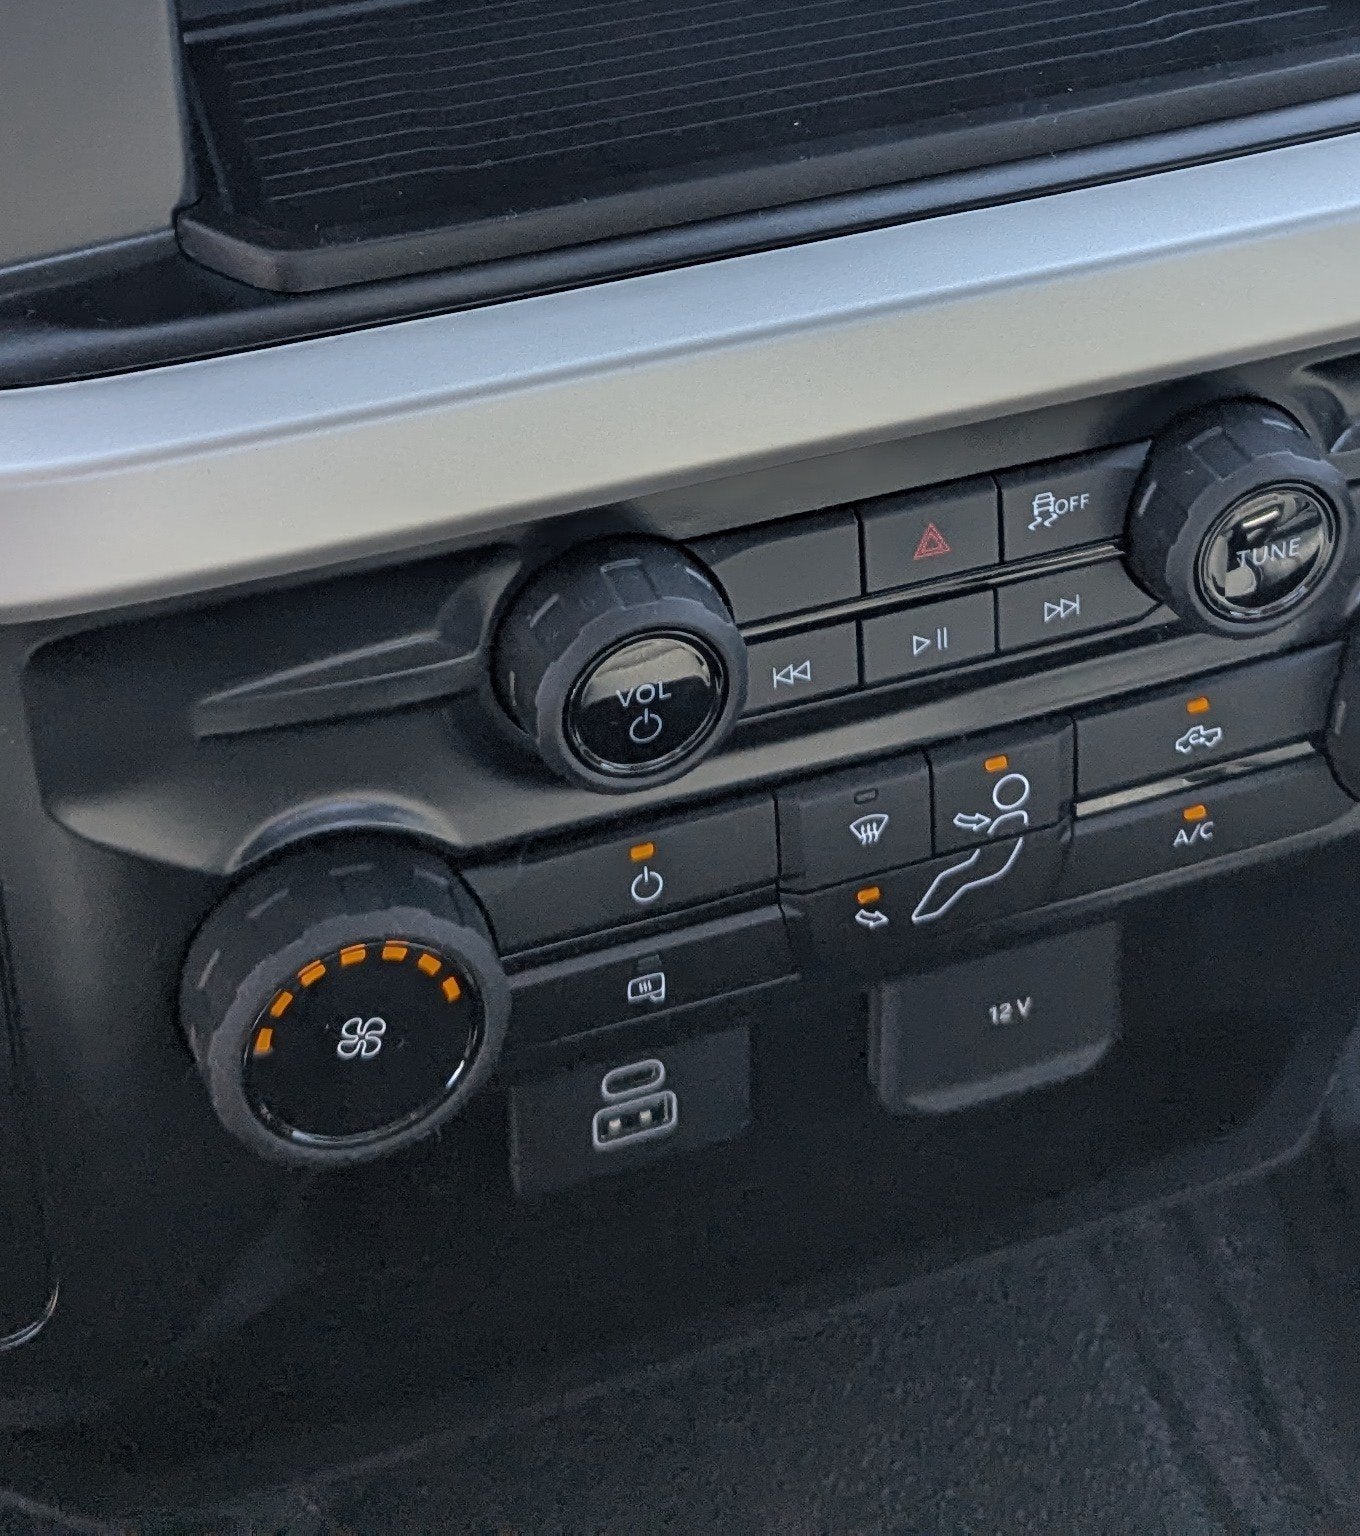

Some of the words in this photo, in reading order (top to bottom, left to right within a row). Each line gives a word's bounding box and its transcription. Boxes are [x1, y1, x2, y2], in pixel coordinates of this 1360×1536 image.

[1053, 492, 1090, 515] OFF
[1236, 536, 1301, 568] TUNE
[616, 680, 672, 708] VOL
[1173, 821, 1215, 848] A/C
